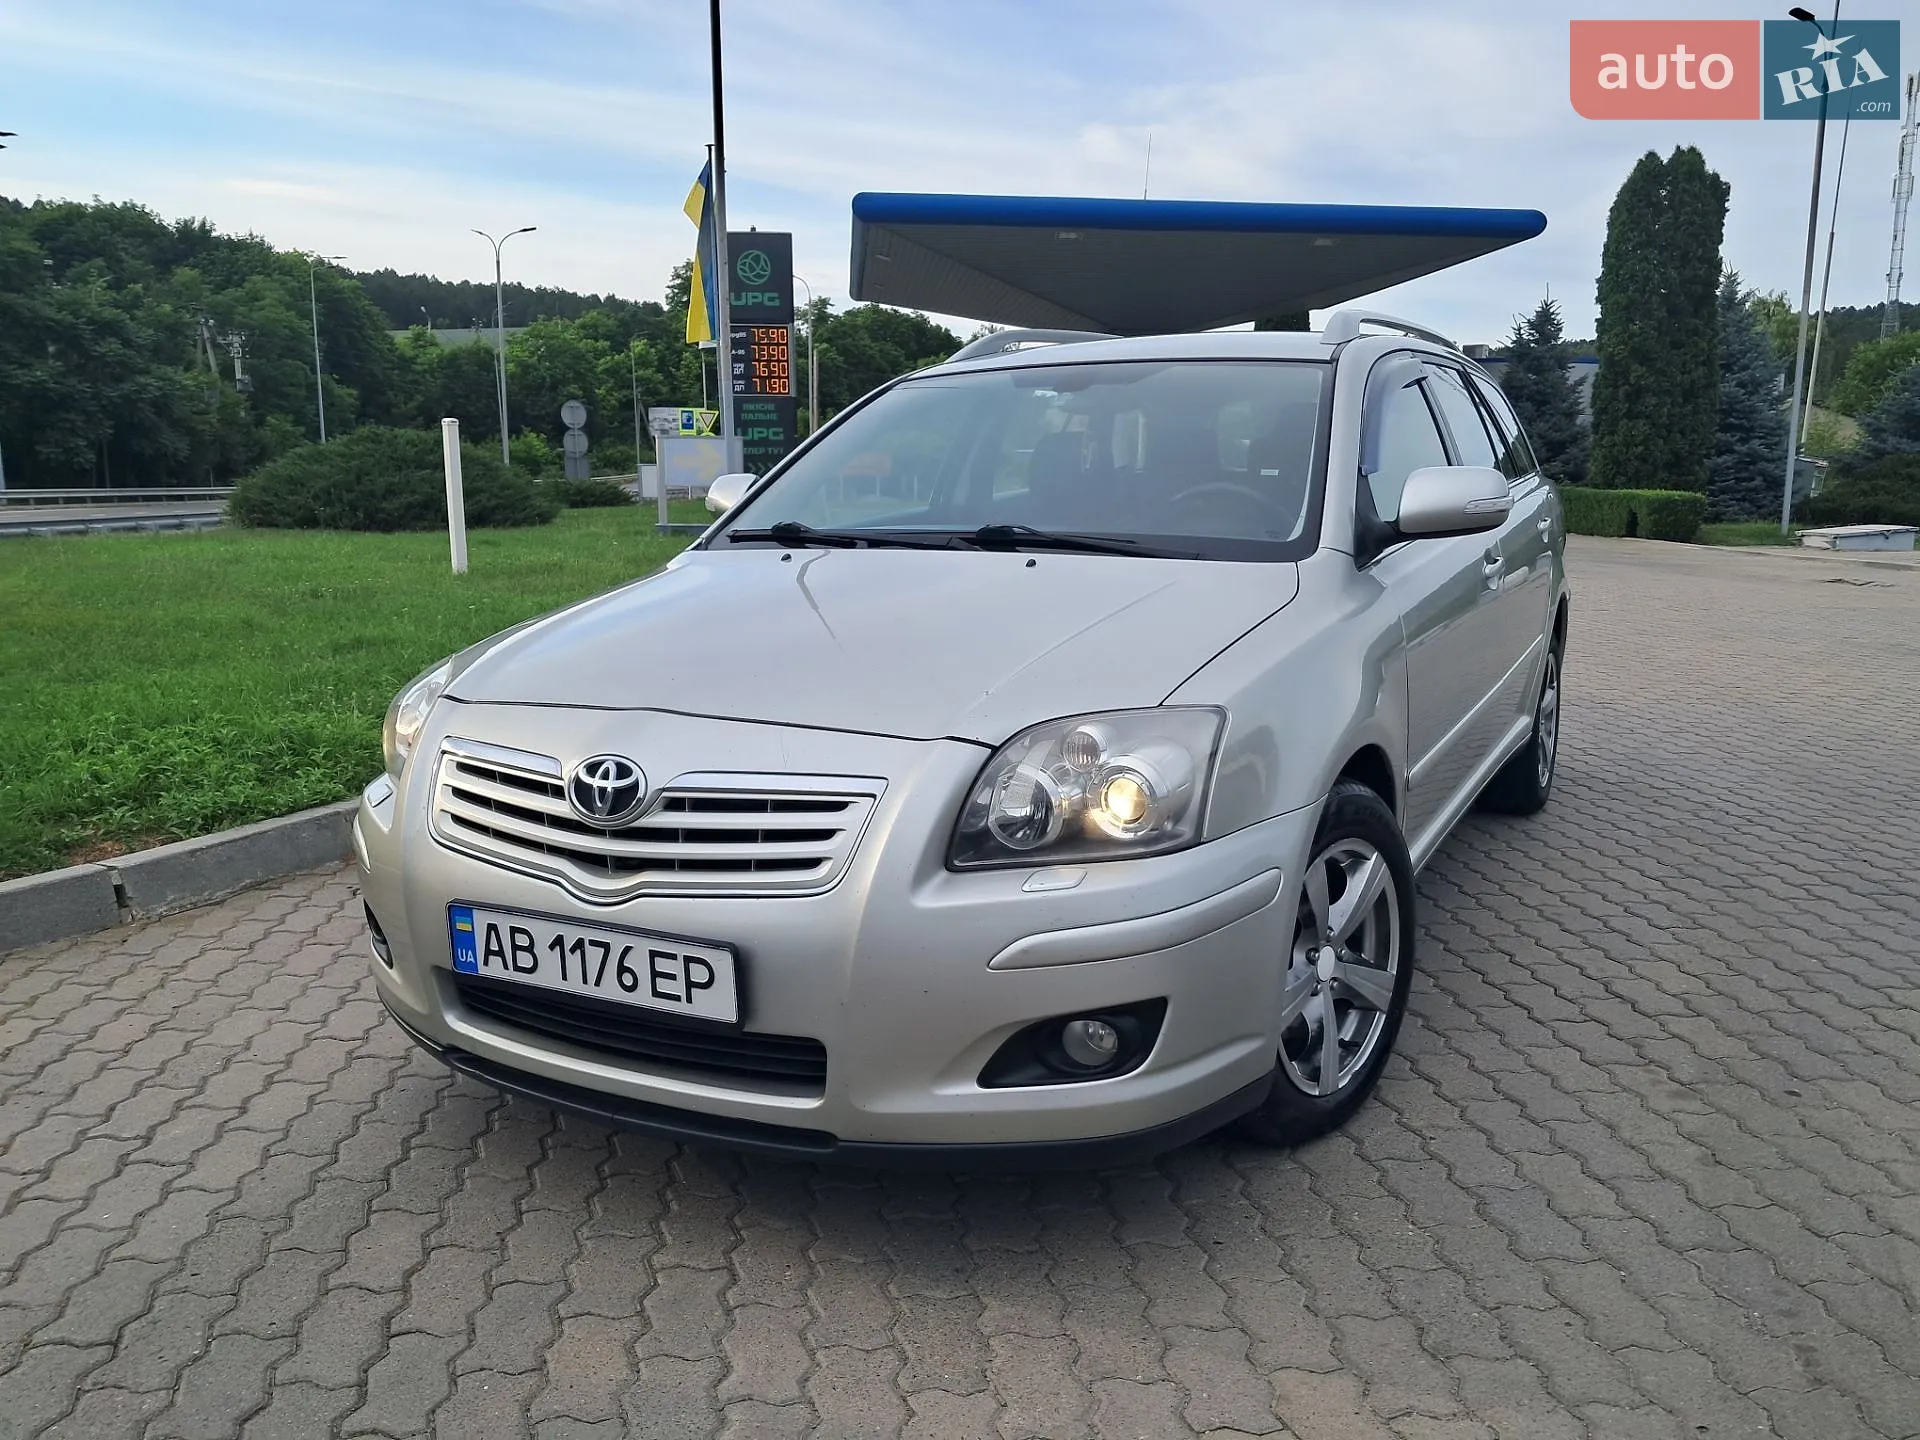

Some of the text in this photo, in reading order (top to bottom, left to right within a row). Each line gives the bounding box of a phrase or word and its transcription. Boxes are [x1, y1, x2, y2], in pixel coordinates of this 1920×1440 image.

[730, 291, 780, 306] UPG
[736, 427, 785, 441] UPG
[458, 922, 715, 1004] UA AB 1176 EP
